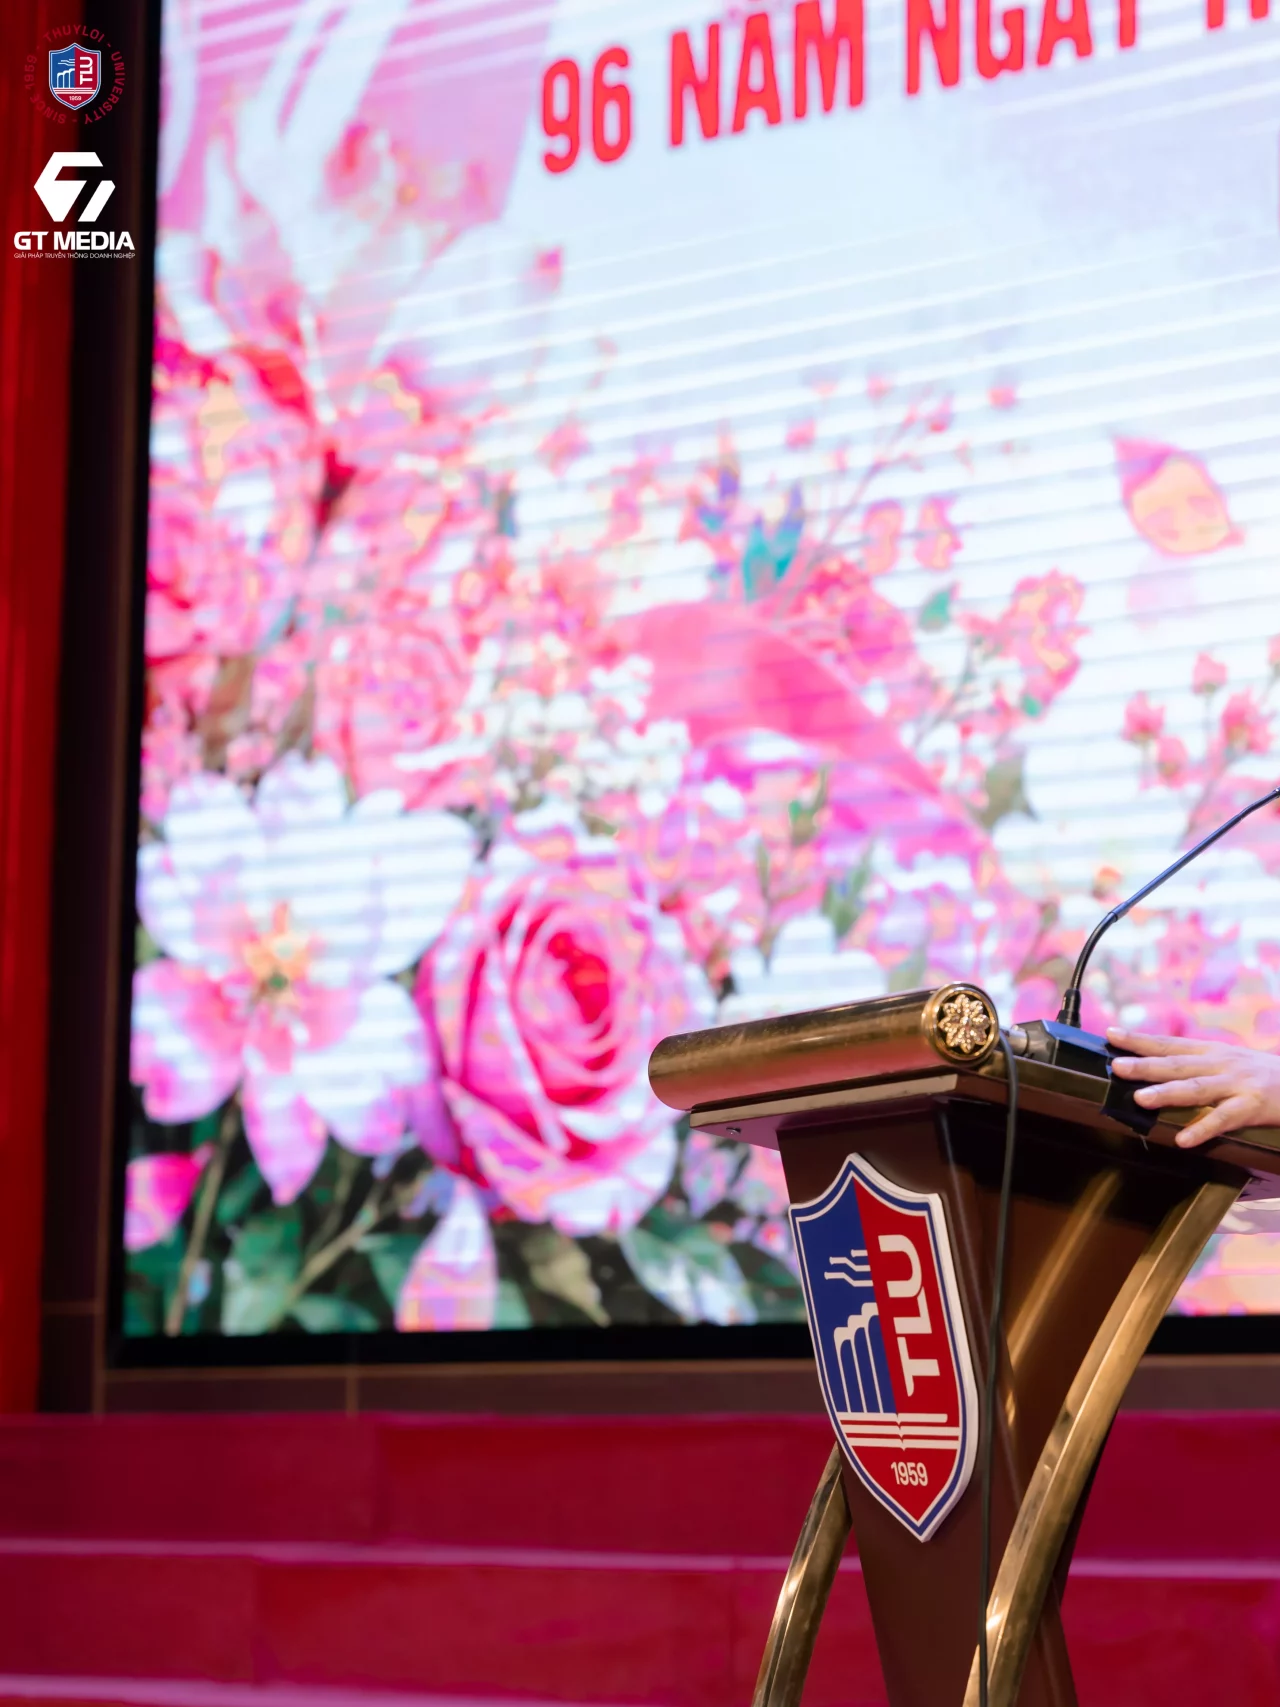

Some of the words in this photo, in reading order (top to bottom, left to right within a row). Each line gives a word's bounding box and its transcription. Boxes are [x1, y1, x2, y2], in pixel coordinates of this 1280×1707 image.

[541, 47, 632, 174] 96
[877, 1234, 941, 1398] TLU
[890, 1461, 929, 1487] 1959
